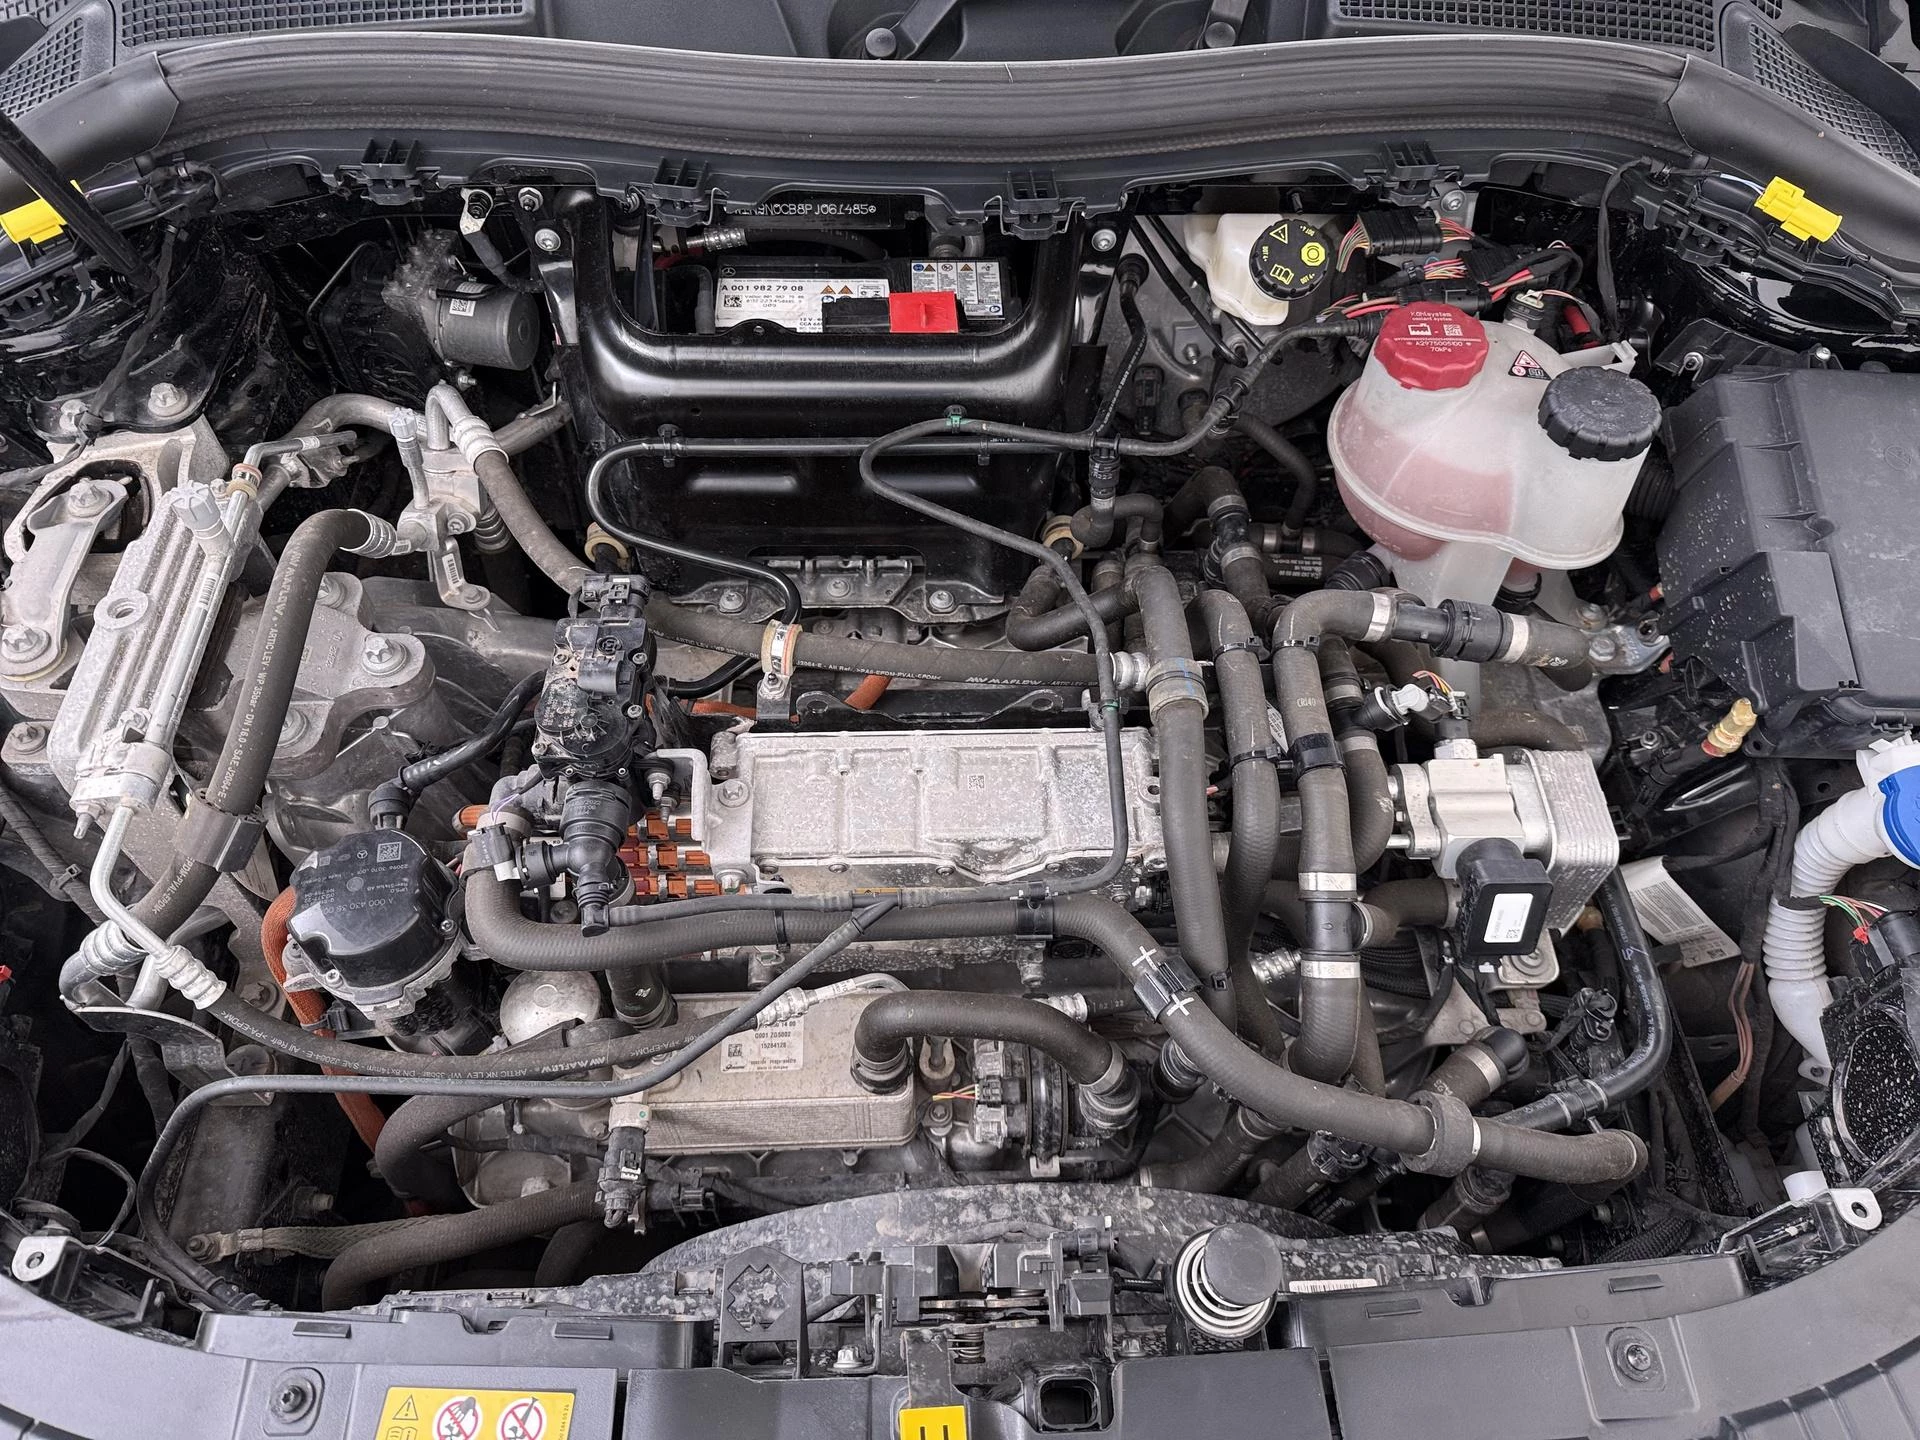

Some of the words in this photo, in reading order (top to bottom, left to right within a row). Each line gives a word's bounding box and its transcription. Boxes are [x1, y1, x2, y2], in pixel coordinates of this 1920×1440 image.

[243, 713, 255, 727] DN
[230, 748, 244, 767] SAE
[500, 1067, 528, 1078] ARTIC
